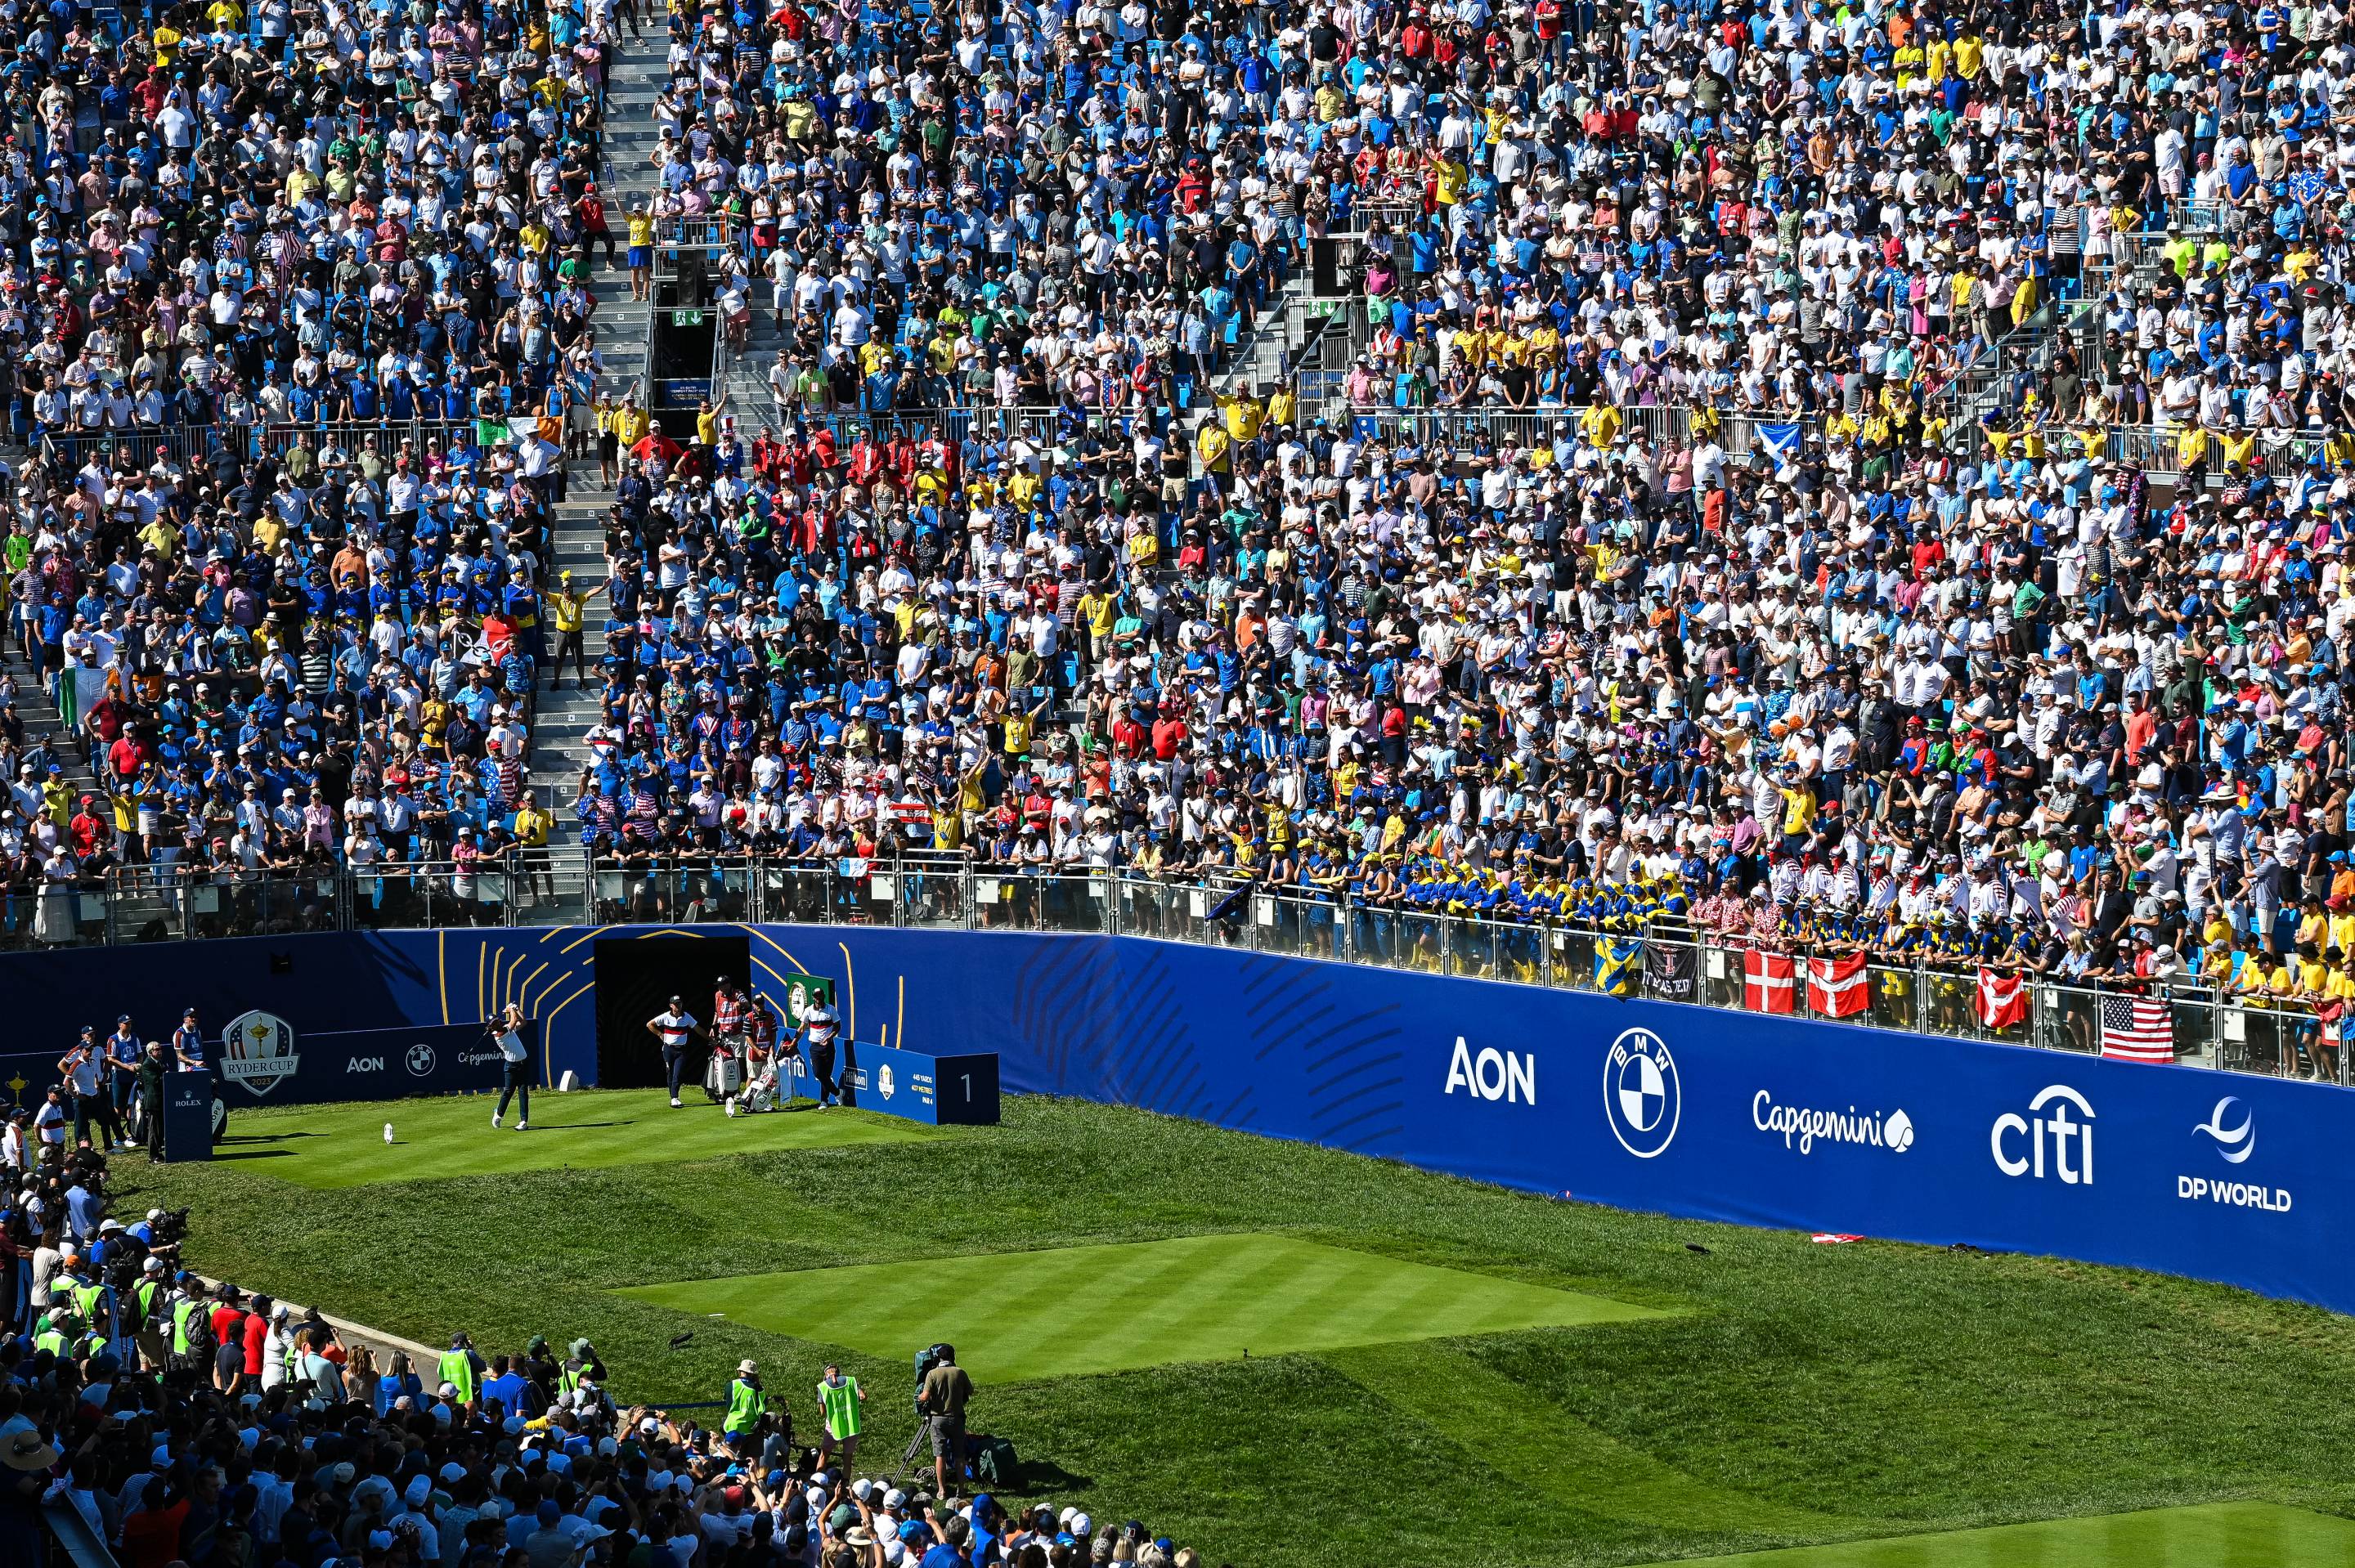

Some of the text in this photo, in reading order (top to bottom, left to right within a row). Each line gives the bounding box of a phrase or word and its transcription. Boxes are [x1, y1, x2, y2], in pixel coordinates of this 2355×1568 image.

[227, 1060, 294, 1074] RYDER CUP
[347, 1057, 384, 1073] AON
[1444, 1036, 1536, 1105] AON
[251, 1077, 271, 1086] 2023
[846, 1070, 866, 1086] Hilton
[920, 1074, 932, 1084] YARDS
[918, 1086, 933, 1095] METRES
[960, 1073, 971, 1103] 1
[1752, 1088, 1883, 1156] Capgemini
[1990, 1104, 2094, 1185] citi
[2178, 1175, 2292, 1213] DP WORLD
